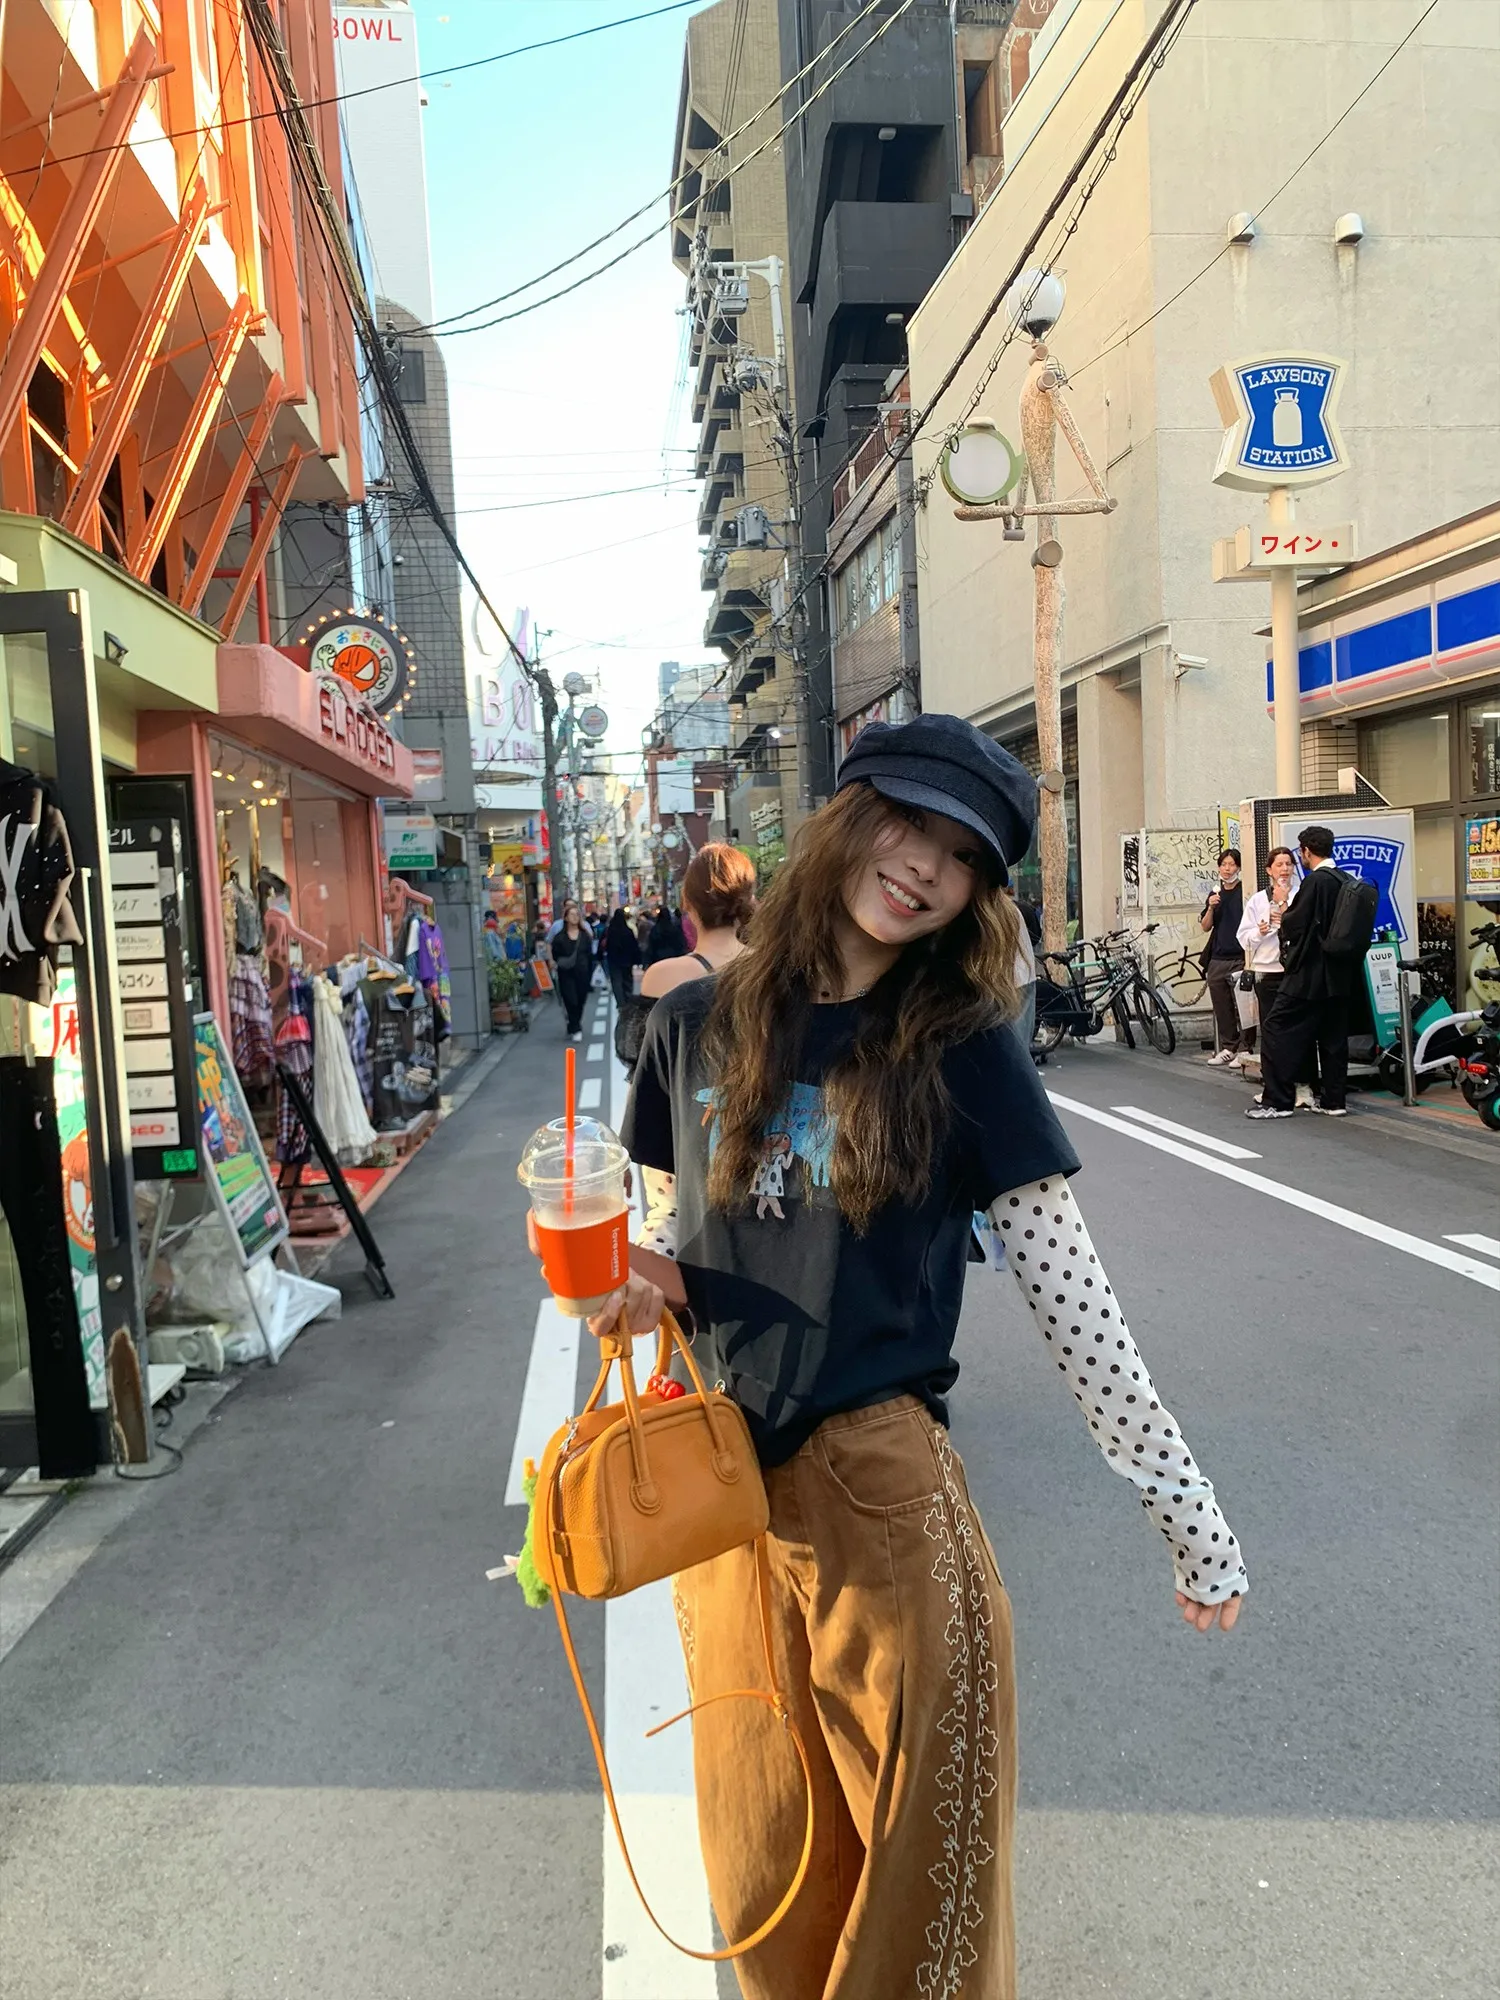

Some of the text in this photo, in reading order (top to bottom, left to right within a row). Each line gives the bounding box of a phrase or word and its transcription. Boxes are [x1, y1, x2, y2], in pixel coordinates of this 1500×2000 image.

[1246, 368, 1327, 389] LAWSON
[1249, 444, 1327, 465] STATION
[1332, 844, 1394, 863] WSON
[1370, 953, 1393, 961] LUUP
